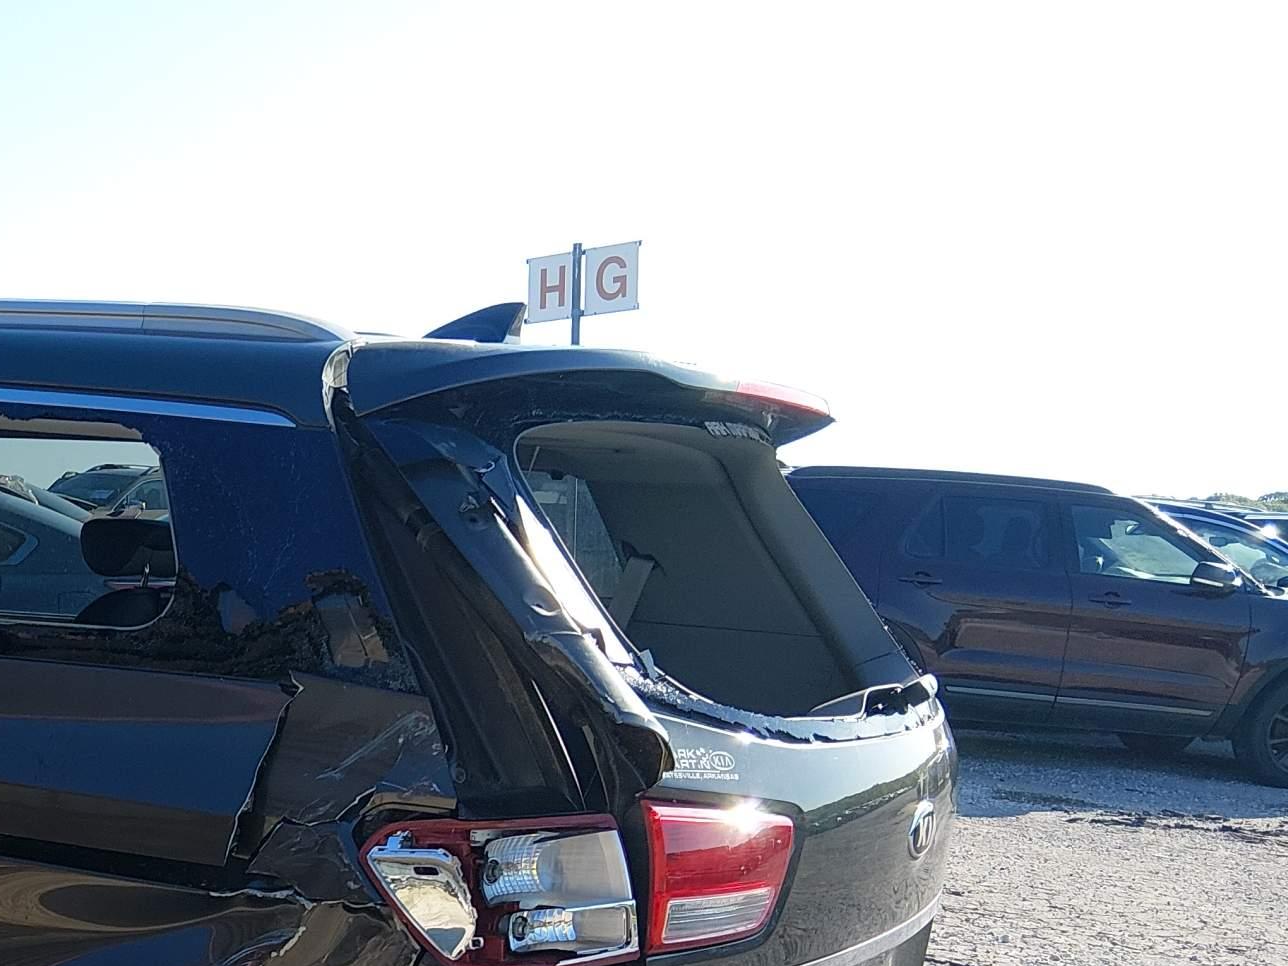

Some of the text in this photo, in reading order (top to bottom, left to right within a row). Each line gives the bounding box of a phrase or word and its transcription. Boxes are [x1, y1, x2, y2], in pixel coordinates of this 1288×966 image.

[539, 265, 566, 310] H
[595, 255, 628, 301] G
[673, 748, 697, 759] ARK
[674, 758, 711, 769] ARTIN
